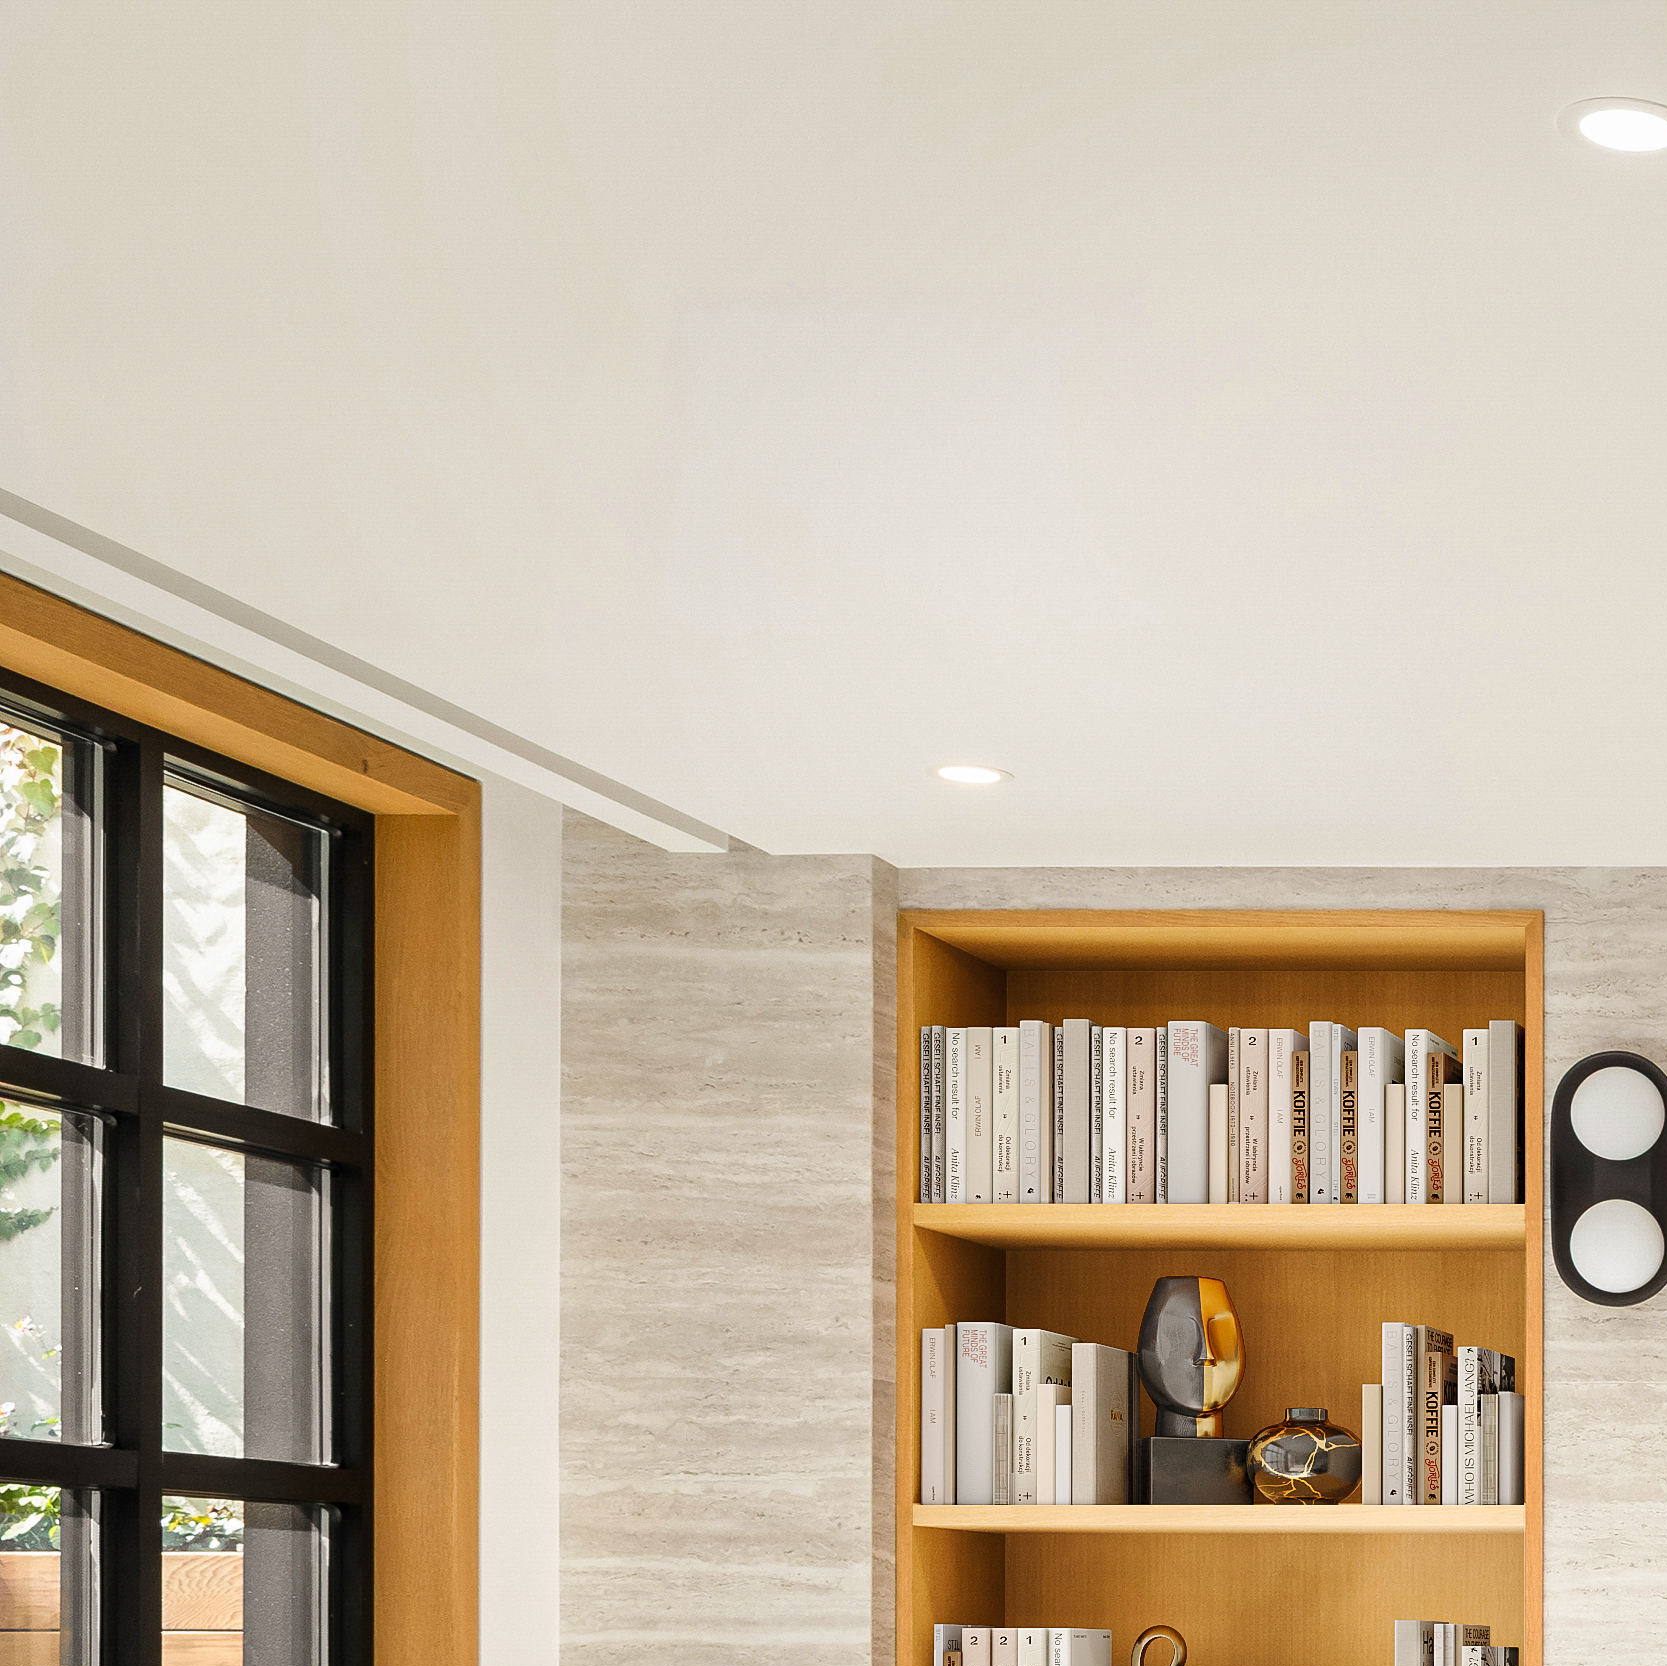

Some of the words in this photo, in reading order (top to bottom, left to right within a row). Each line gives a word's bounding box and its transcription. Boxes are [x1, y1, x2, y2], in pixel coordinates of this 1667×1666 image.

[1172, 1028, 1182, 1056] FUTURE
[1181, 1028, 1190, 1051] MINDS
[1189, 1028, 1199, 1043] THE
[1248, 1036, 1257, 1046] 2
[1471, 1036, 1478, 1046] 1
[1181, 1051, 1190, 1062] OF
[1189, 1043, 1199, 1068] GREAT
[1293, 1091, 1305, 1137] KOFFIE
[1465, 1359, 1474, 1397] JANG?
[1465, 1399, 1474, 1454] MICHAEL
[1465, 1458, 1474, 1468] IS
[1465, 1472, 1474, 1504] WHO
[1054, 1633, 1063, 1646] No
